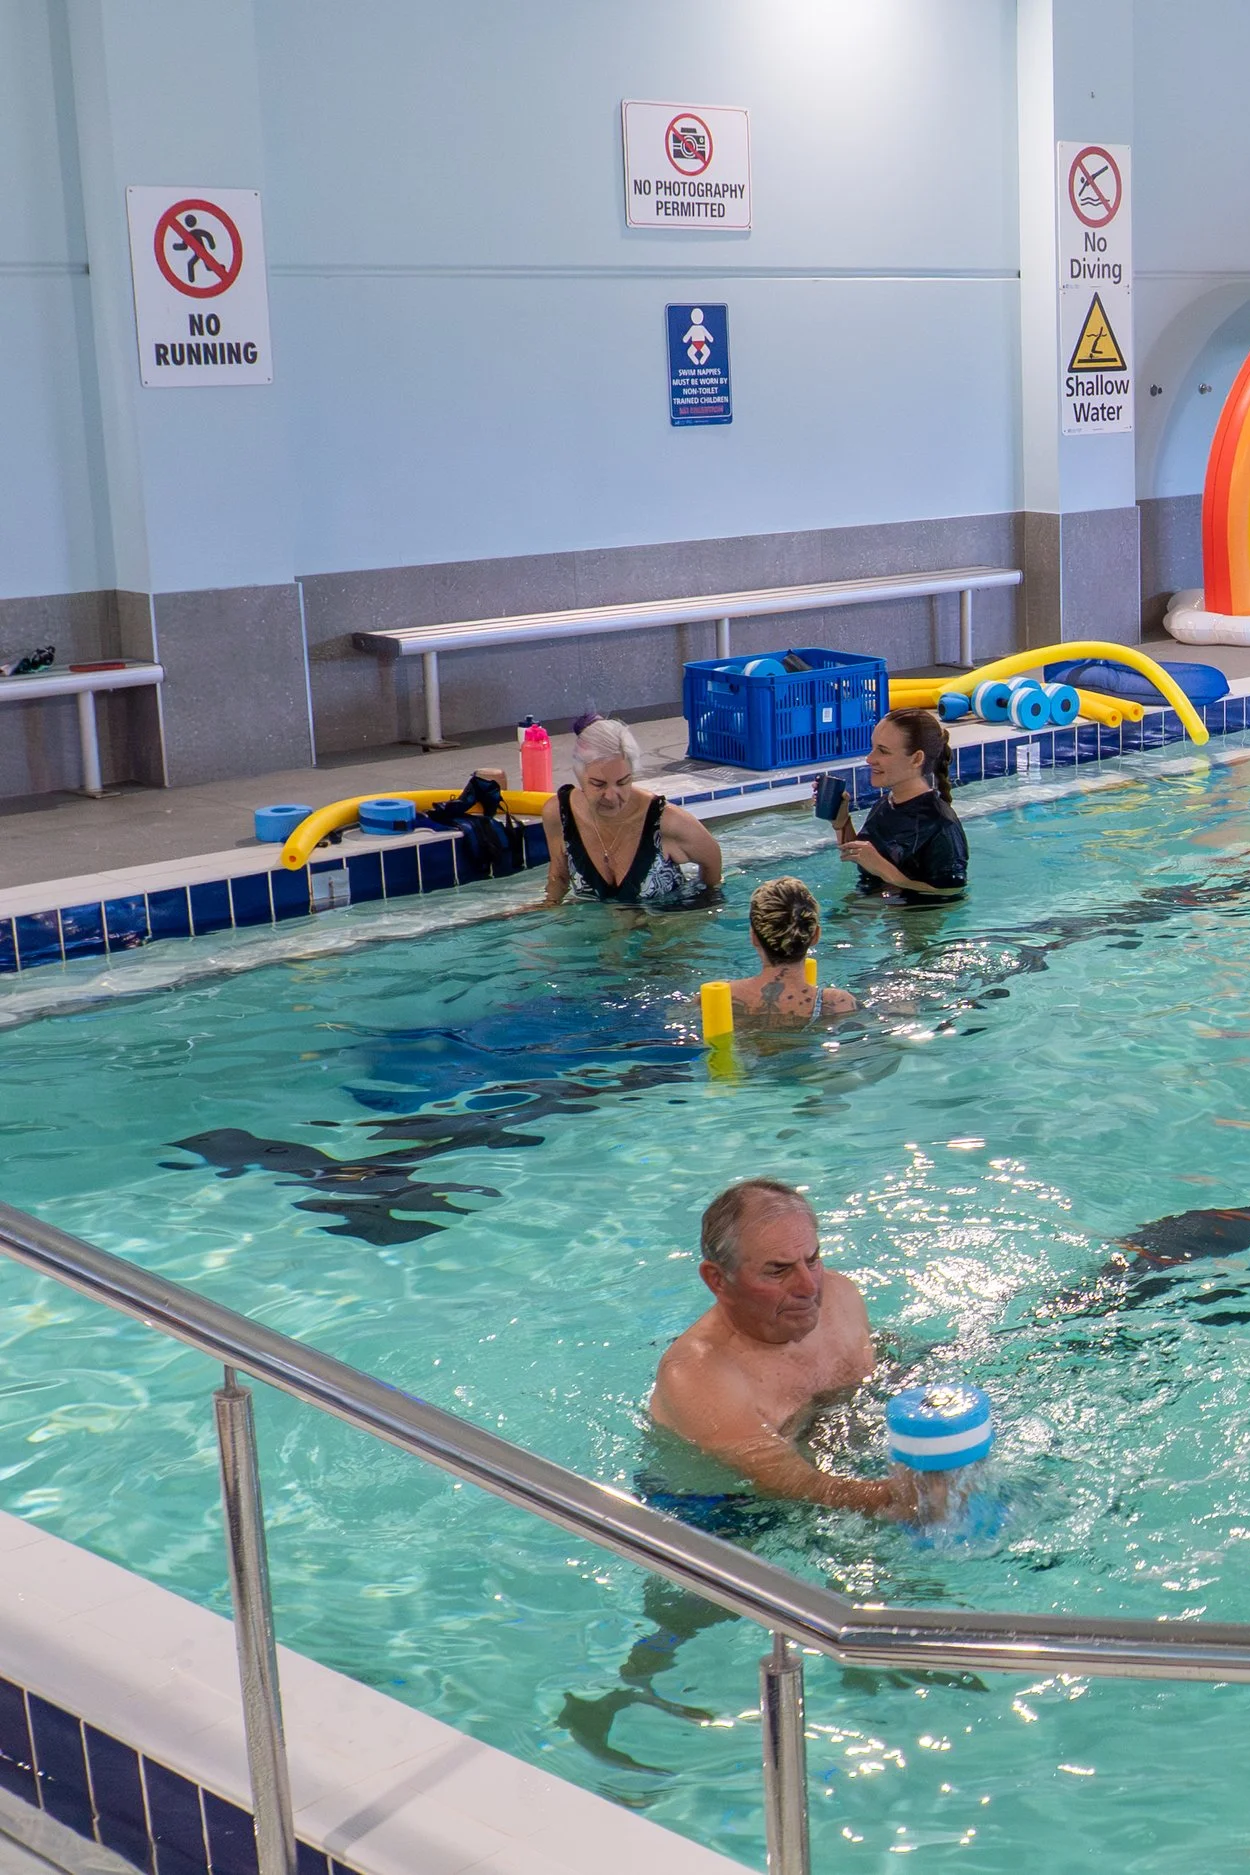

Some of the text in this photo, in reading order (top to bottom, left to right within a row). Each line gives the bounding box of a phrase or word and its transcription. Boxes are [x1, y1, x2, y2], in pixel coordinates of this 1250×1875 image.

[633, 179, 745, 199] NO PHOTOGRAPHY
[656, 200, 726, 218] PERMITTED
[1084, 231, 1107, 252] No
[1070, 257, 1122, 285] Diving
[188, 313, 221, 337] NO
[154, 341, 258, 367] RUNNING
[672, 378, 690, 386] MUST
[699, 377, 718, 385] WORN
[678, 368, 721, 376] SWIM NAPPIES
[682, 387, 718, 395] NON-TOILET
[1065, 374, 1130, 397] Shallow
[673, 396, 729, 405] TRAINED CHILDREN
[1073, 402, 1123, 423] Water
